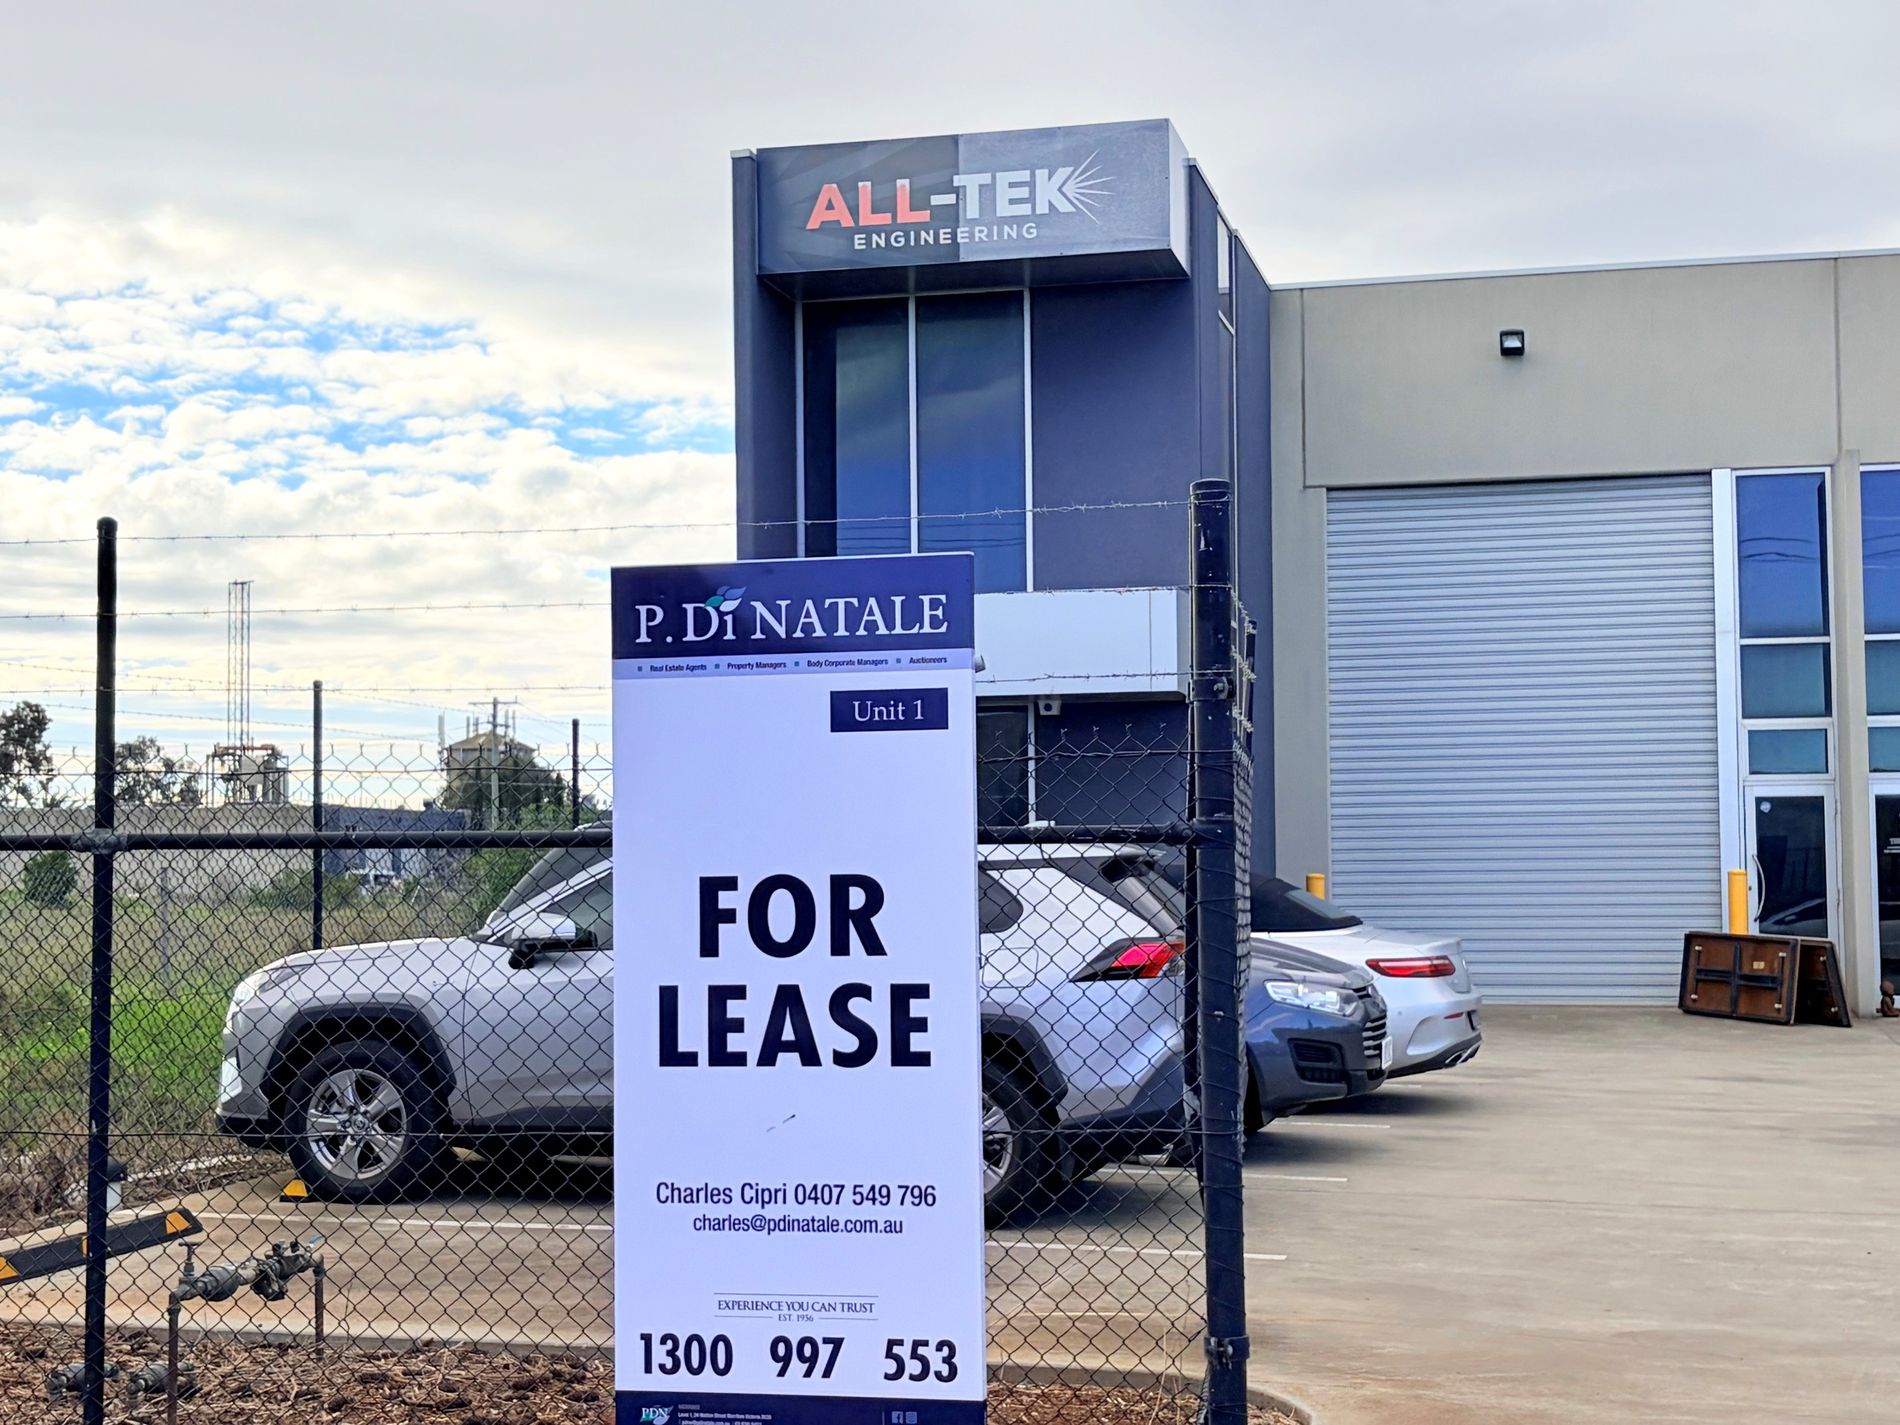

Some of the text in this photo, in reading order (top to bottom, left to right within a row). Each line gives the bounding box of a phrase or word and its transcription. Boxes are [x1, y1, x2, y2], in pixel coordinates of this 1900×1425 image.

[805, 166, 1077, 230] ALL-TEK
[853, 222, 1039, 250] ENGINEERING
[634, 605, 674, 644] P.
[750, 594, 949, 640] NATALE
[650, 663, 707, 672] Real Estate Agents
[727, 661, 787, 670] Property Managers
[807, 658, 889, 668] Body Corporate Managers
[909, 656, 948, 664] Auctioneers
[853, 699, 925, 721] Unit 1
[699, 873, 888, 958] FOR
[658, 982, 931, 1068] LEASE
[656, 1182, 937, 1209] Charles Cipri 0407 549 796
[693, 1213, 903, 1235] charles@pdinatale.com.au
[717, 1299, 875, 1314] EXPERIENCE YOU CAN TRUST
[778, 1313, 794, 1322] EST.
[640, 1332, 958, 1383] 1300 997 553
[641, 1407, 670, 1419] PDN
